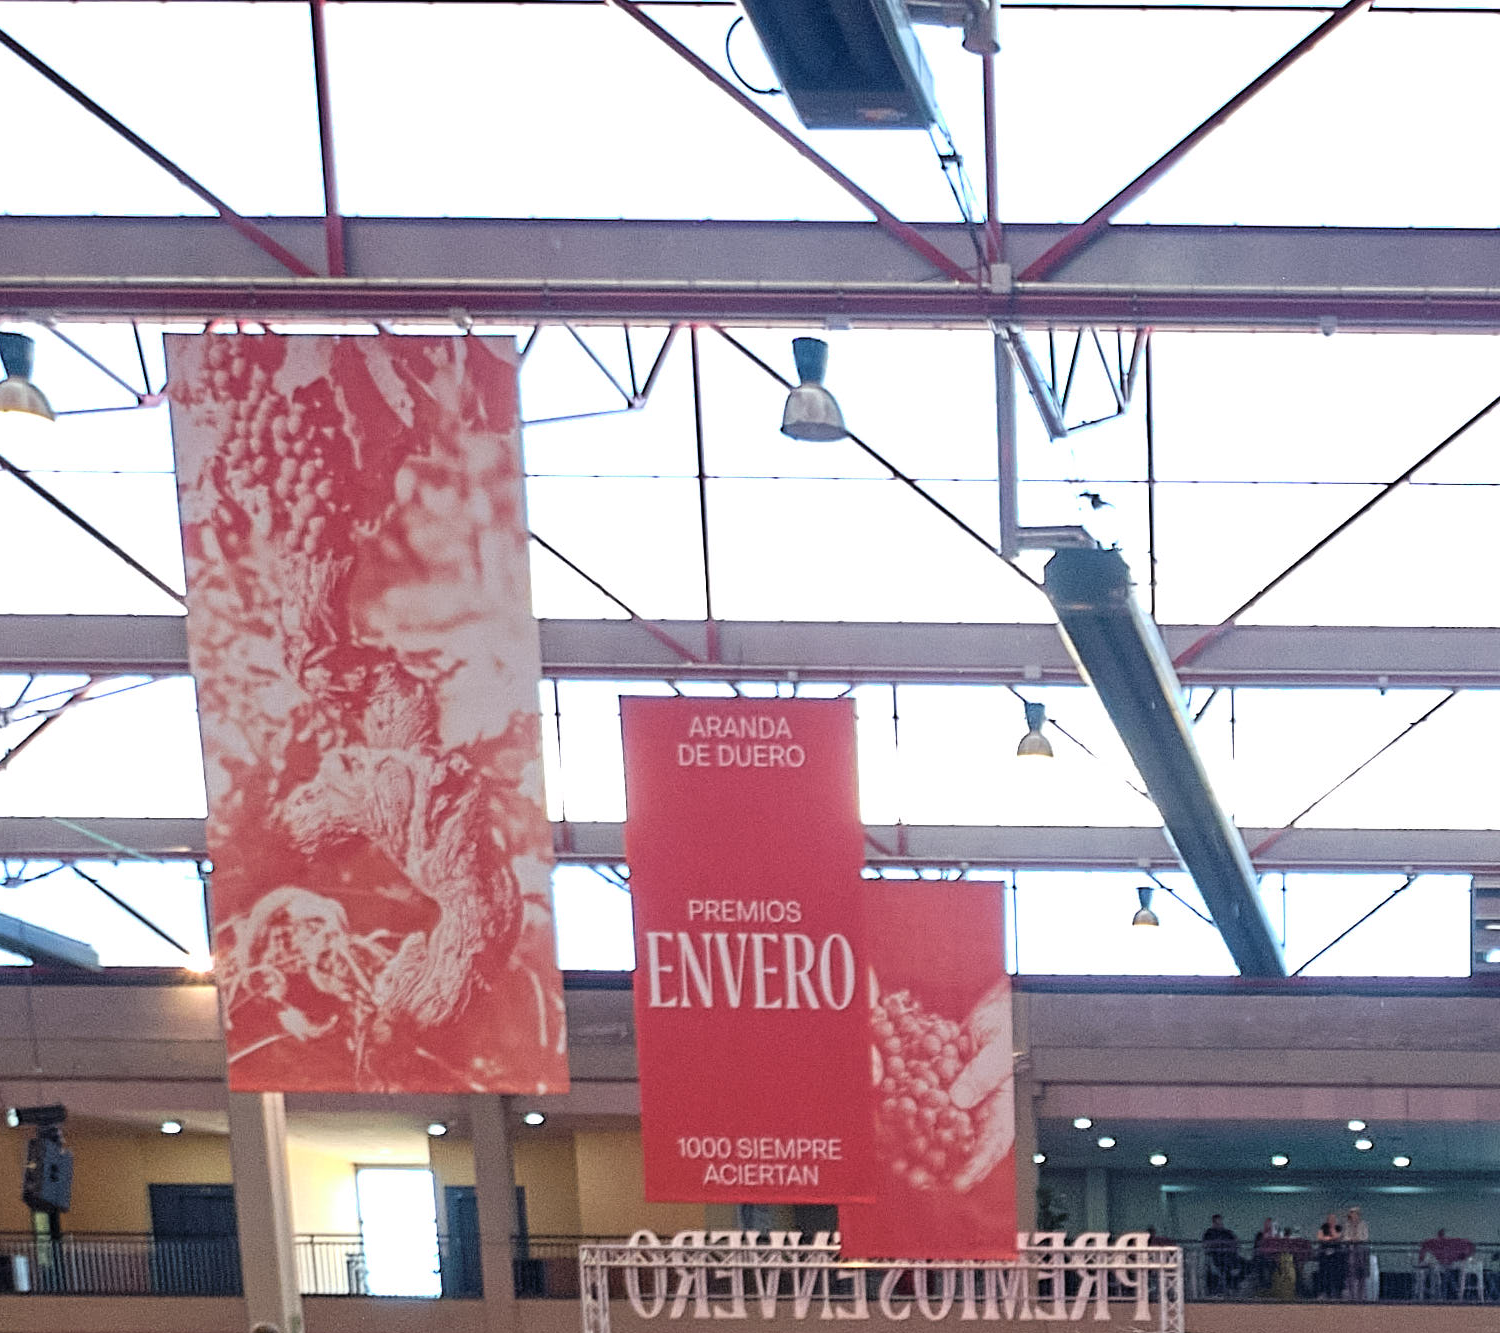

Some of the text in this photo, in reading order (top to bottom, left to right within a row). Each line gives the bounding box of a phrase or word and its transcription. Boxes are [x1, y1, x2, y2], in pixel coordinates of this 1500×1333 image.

[689, 716, 792, 739] ARANDA
[678, 744, 805, 768] DE DUERO
[688, 900, 801, 923] PREMIOS
[646, 932, 856, 1011] ENVERO
[678, 1138, 842, 1161] 1000 SIEMPRE
[703, 1164, 819, 1186] ACIERTAN
